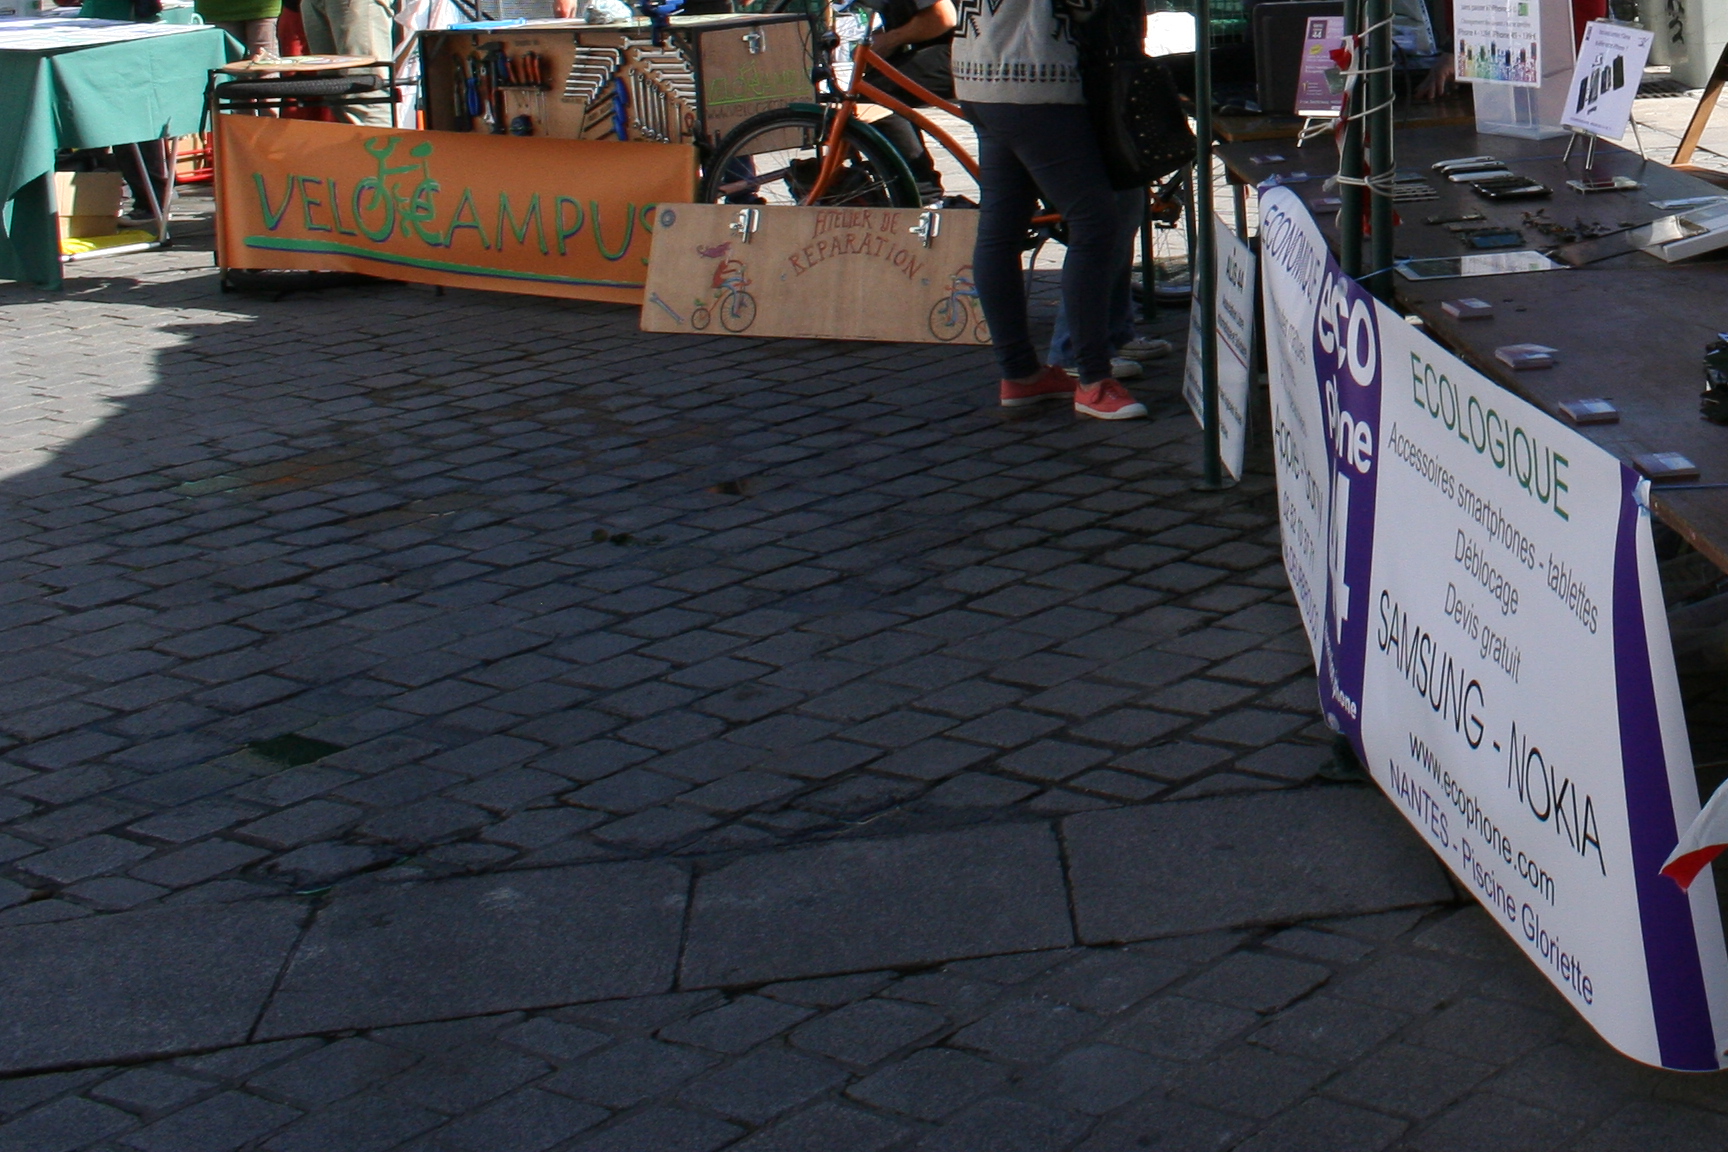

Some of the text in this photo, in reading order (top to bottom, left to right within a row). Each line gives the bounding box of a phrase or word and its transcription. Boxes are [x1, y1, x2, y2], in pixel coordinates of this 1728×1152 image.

[788, 232, 926, 280] REPARATION
[812, 209, 900, 239] ATELIER DE
[1410, 350, 1569, 522] ECOLOGIQUE
[1388, 422, 1455, 500] Accessoires
[1457, 482, 1535, 570] smartphones
[1546, 552, 1599, 634] tablettes
[1454, 528, 1519, 615] Déblocage
[1444, 581, 1521, 684] Devis gratuit
[1377, 589, 1485, 749] SAMSUNG
[1507, 720, 1607, 876] NOKIA
[1389, 758, 1449, 848] NANTES
[1460, 836, 1516, 922] Piscine
[1521, 901, 1594, 1006] Gloriette
[1409, 731, 1555, 907] www.ecophone.com
